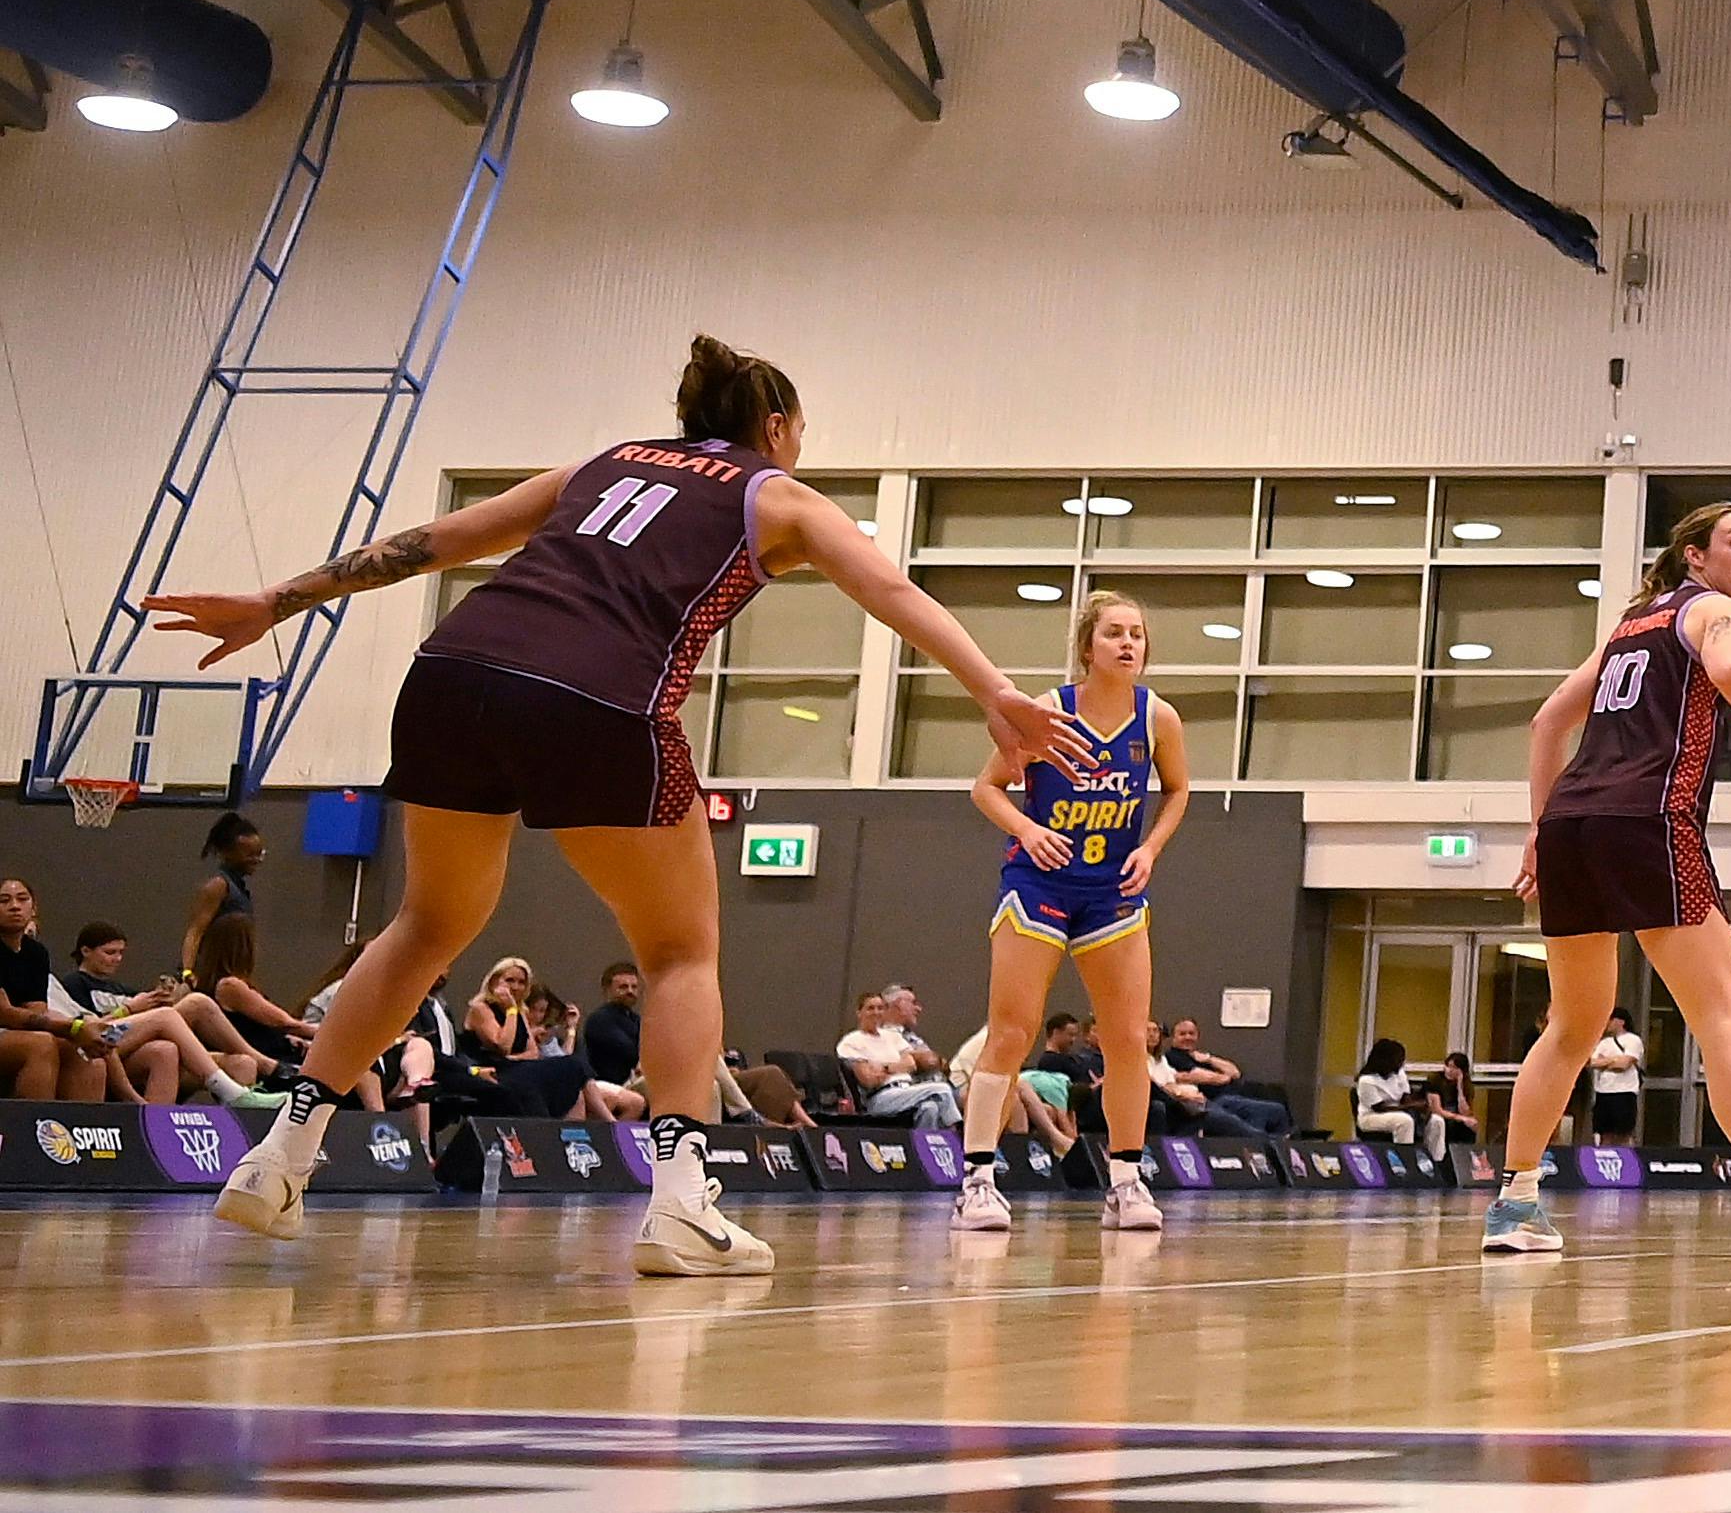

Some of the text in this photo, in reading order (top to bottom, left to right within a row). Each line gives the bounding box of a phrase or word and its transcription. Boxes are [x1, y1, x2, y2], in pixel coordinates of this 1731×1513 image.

[612, 444, 743, 483] ROBATI
[576, 476, 679, 547] 11
[1593, 649, 1650, 714] 10
[1049, 798, 1142, 831] SPIRIT
[1083, 833, 1106, 865] 8
[169, 1112, 213, 1126] WNBL
[72, 1126, 122, 1151] SPIRIT
